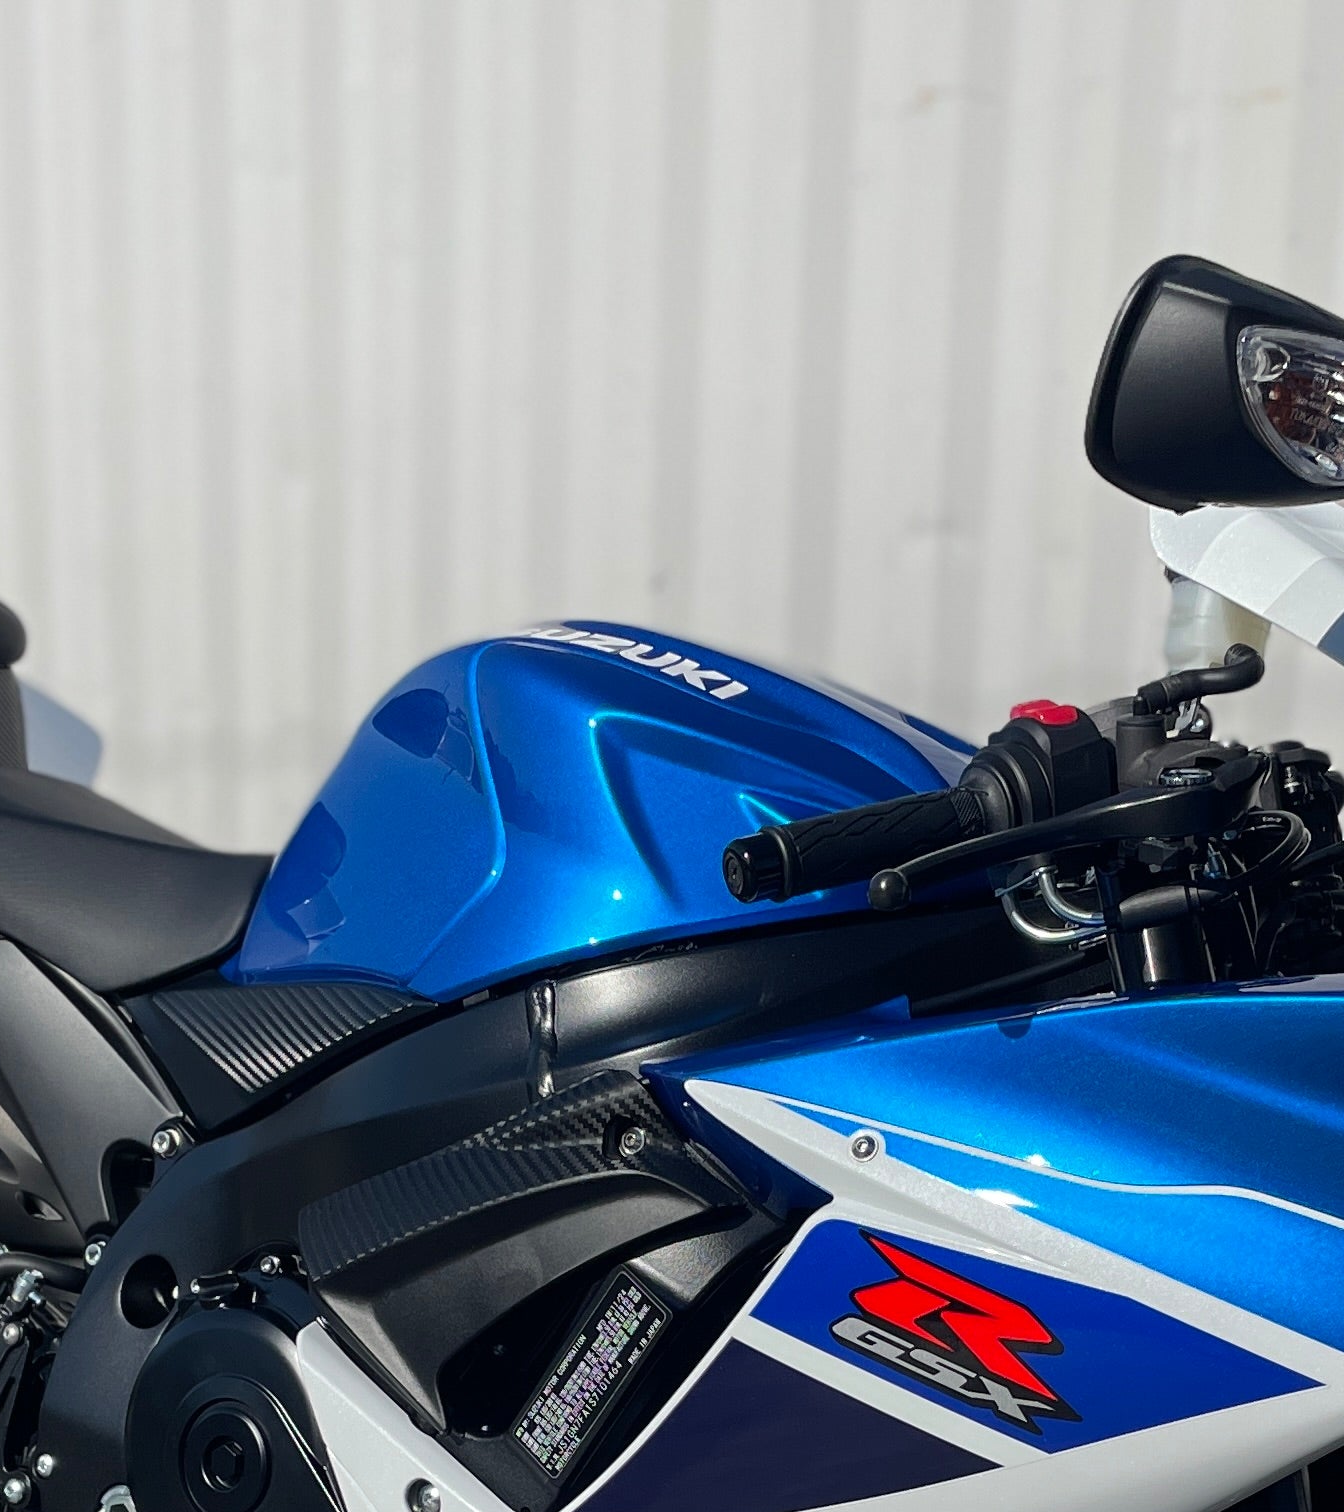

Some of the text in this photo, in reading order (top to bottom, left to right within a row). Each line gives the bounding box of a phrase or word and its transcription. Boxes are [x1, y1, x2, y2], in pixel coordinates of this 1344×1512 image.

[526, 1394, 545, 1420] SUZUKI
[542, 1373, 559, 1397] MOTOR
[555, 1332, 587, 1376] CORPORATION
[626, 1346, 642, 1365] MADE
[644, 1317, 662, 1339] JAPAN
[830, 1316, 1057, 1424] GSX
